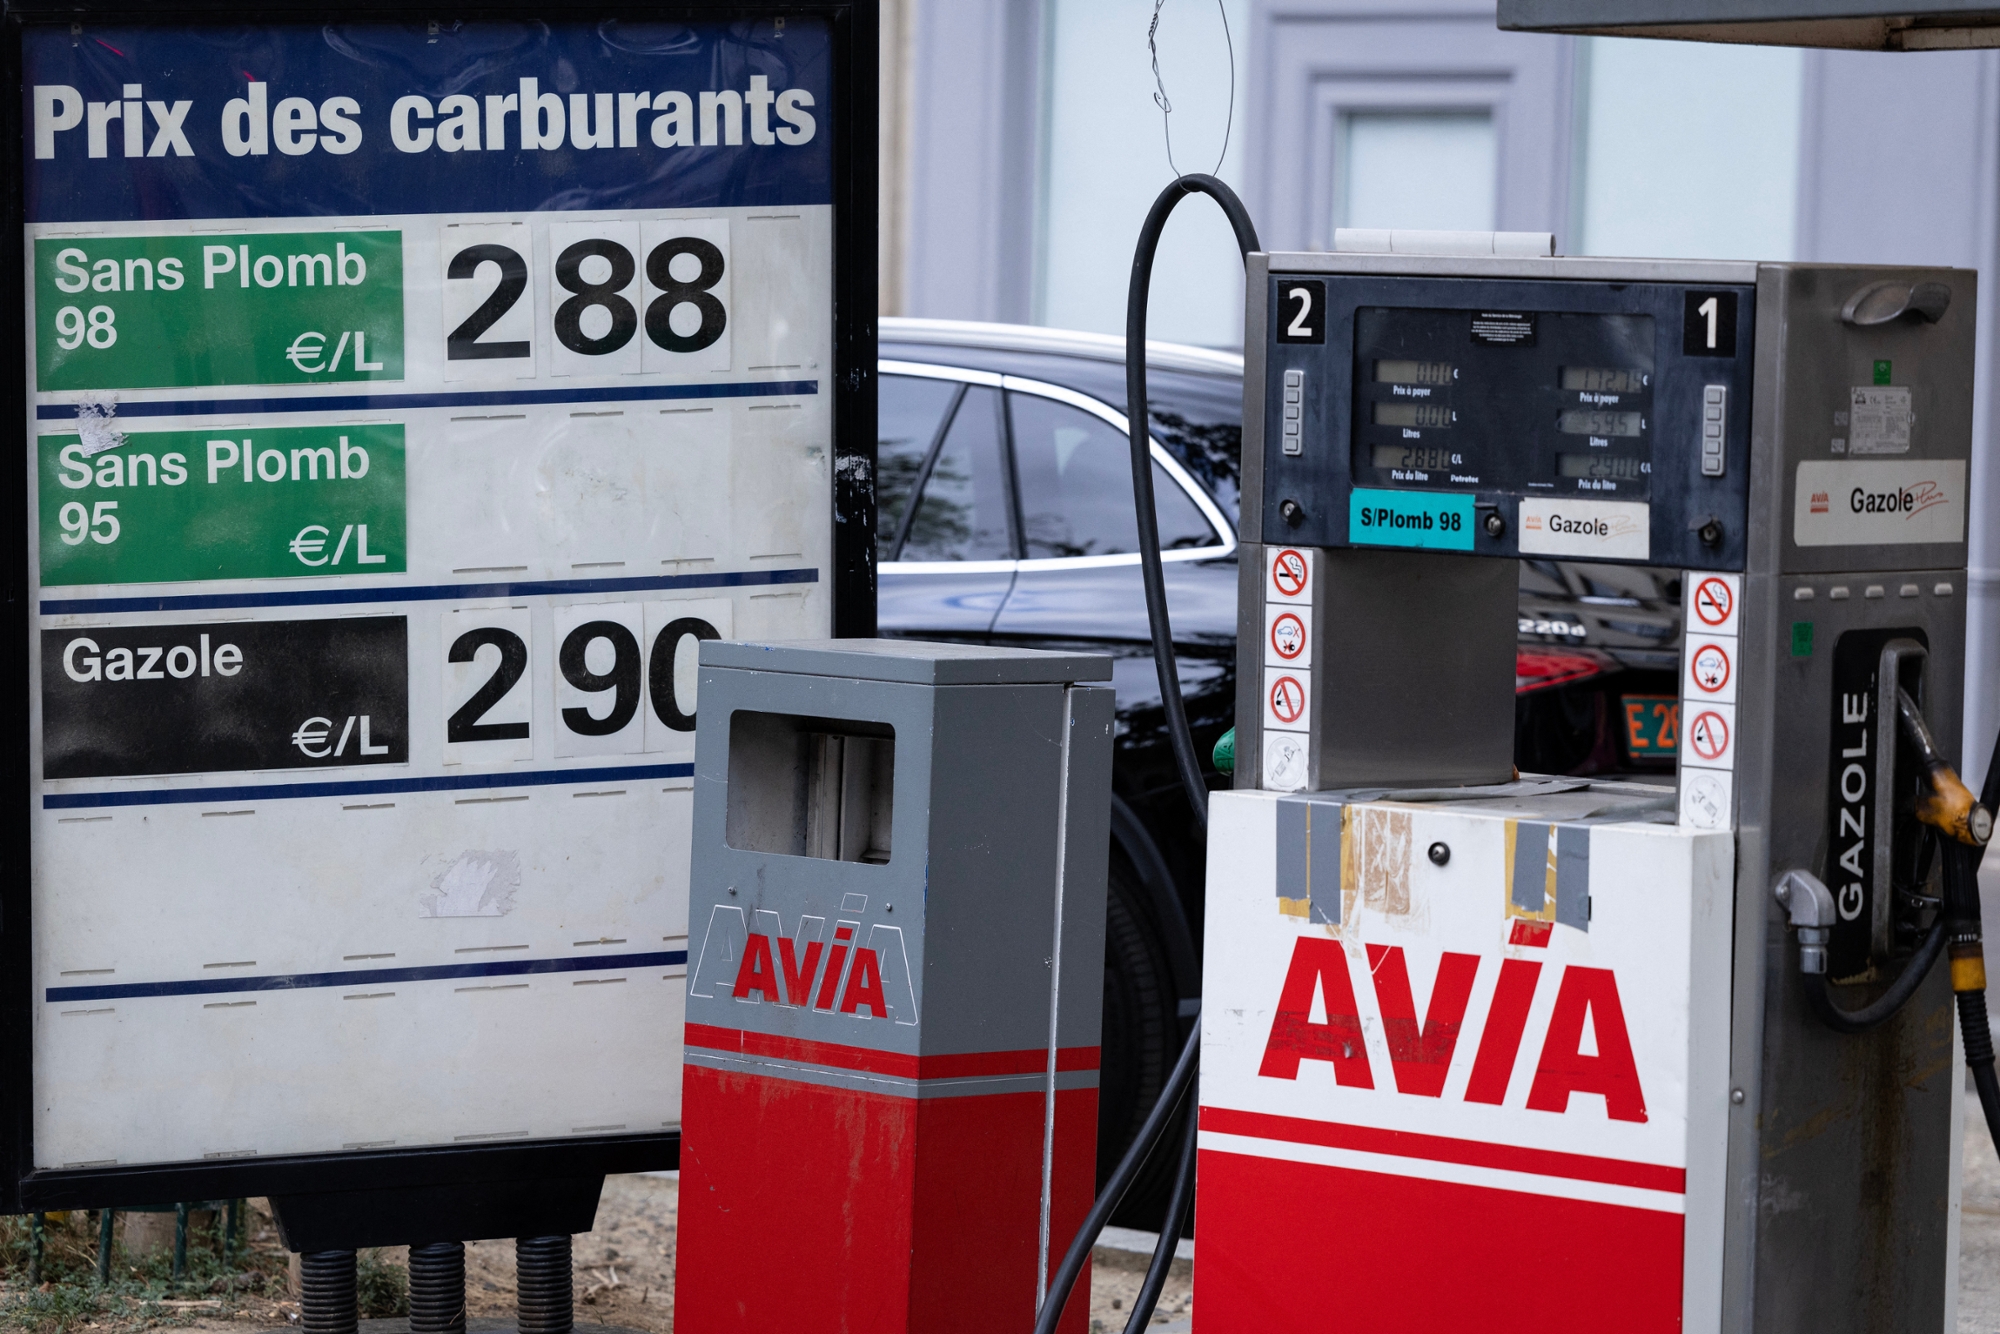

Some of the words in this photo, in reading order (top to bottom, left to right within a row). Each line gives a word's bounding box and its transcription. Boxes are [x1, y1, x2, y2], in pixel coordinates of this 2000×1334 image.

[33, 83, 196, 160] Prix
[221, 81, 363, 156] des
[390, 75, 817, 153] carburants
[54, 247, 185, 294] Sans
[203, 242, 367, 290] Plomb
[54, 305, 118, 350] 98
[1287, 287, 1312, 337] 2
[1698, 296, 1718, 349] 1
[285, 330, 384, 373] €/L
[1393, 384, 1406, 396] Prix
[1412, 387, 1431, 399] payer
[1579, 391, 1593, 403] Prix
[1599, 394, 1619, 406] payer
[1402, 427, 1420, 439] Litres
[1589, 435, 1608, 448] Litres
[58, 443, 188, 490] Sans
[206, 436, 370, 484] Plomb
[1391, 469, 1404, 481] Prix
[1405, 470, 1414, 481] du
[1414, 470, 1429, 481] litre
[1578, 478, 1591, 490] Prix
[1592, 479, 1601, 490] du
[1602, 480, 1617, 491] litre
[1361, 507, 1434, 530] S/Plomb
[1439, 511, 1462, 532] 98
[1850, 487, 1914, 513] Gazole
[58, 500, 121, 546] 95
[289, 523, 387, 567] €/L
[1549, 514, 1609, 536] Gazole
[62, 633, 244, 683] Gazole
[291, 714, 389, 758] €/L
[1626, 703, 1649, 748] E
[1838, 692, 1868, 922] GAZOLE
